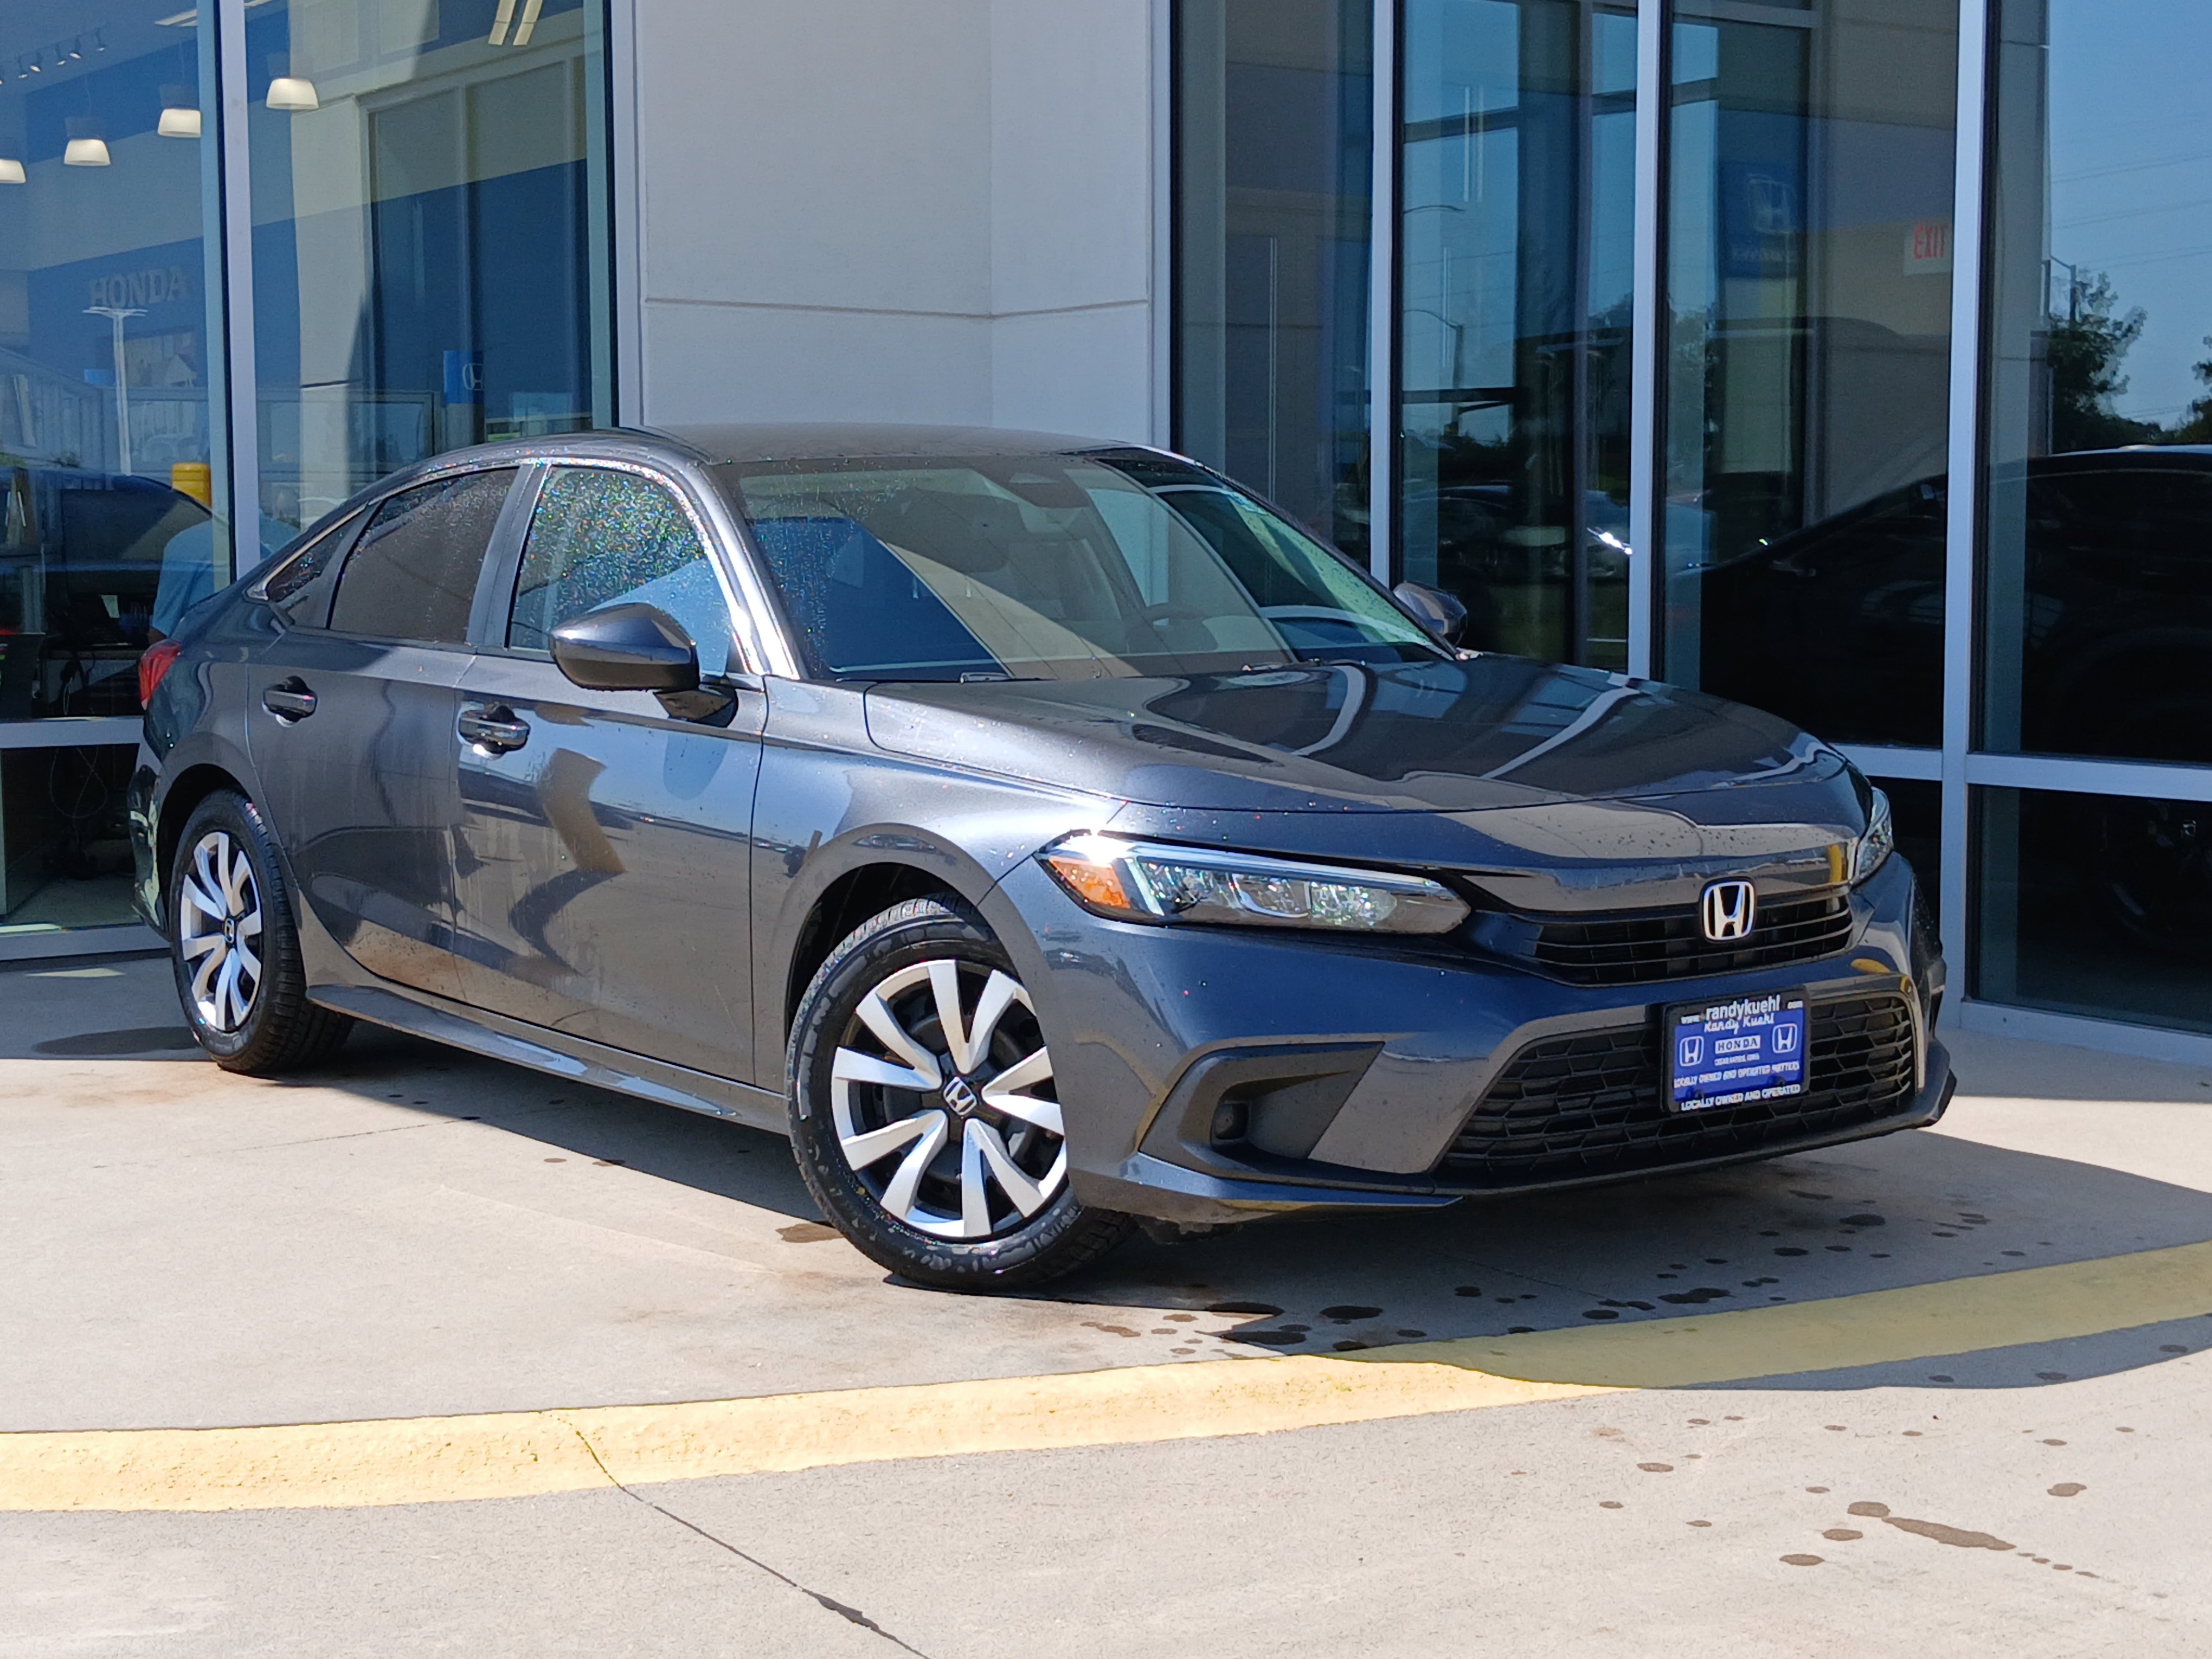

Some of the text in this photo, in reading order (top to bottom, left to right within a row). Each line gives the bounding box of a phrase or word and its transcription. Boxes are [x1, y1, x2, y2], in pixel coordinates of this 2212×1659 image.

[91, 265, 187, 308] HONDA
[1706, 995, 1780, 1021] randykuehl
[1743, 1013, 1774, 1027] Kuehl
[1718, 1040, 1758, 1050] HONDA
[1682, 1097, 1714, 1110] LOCALLY
